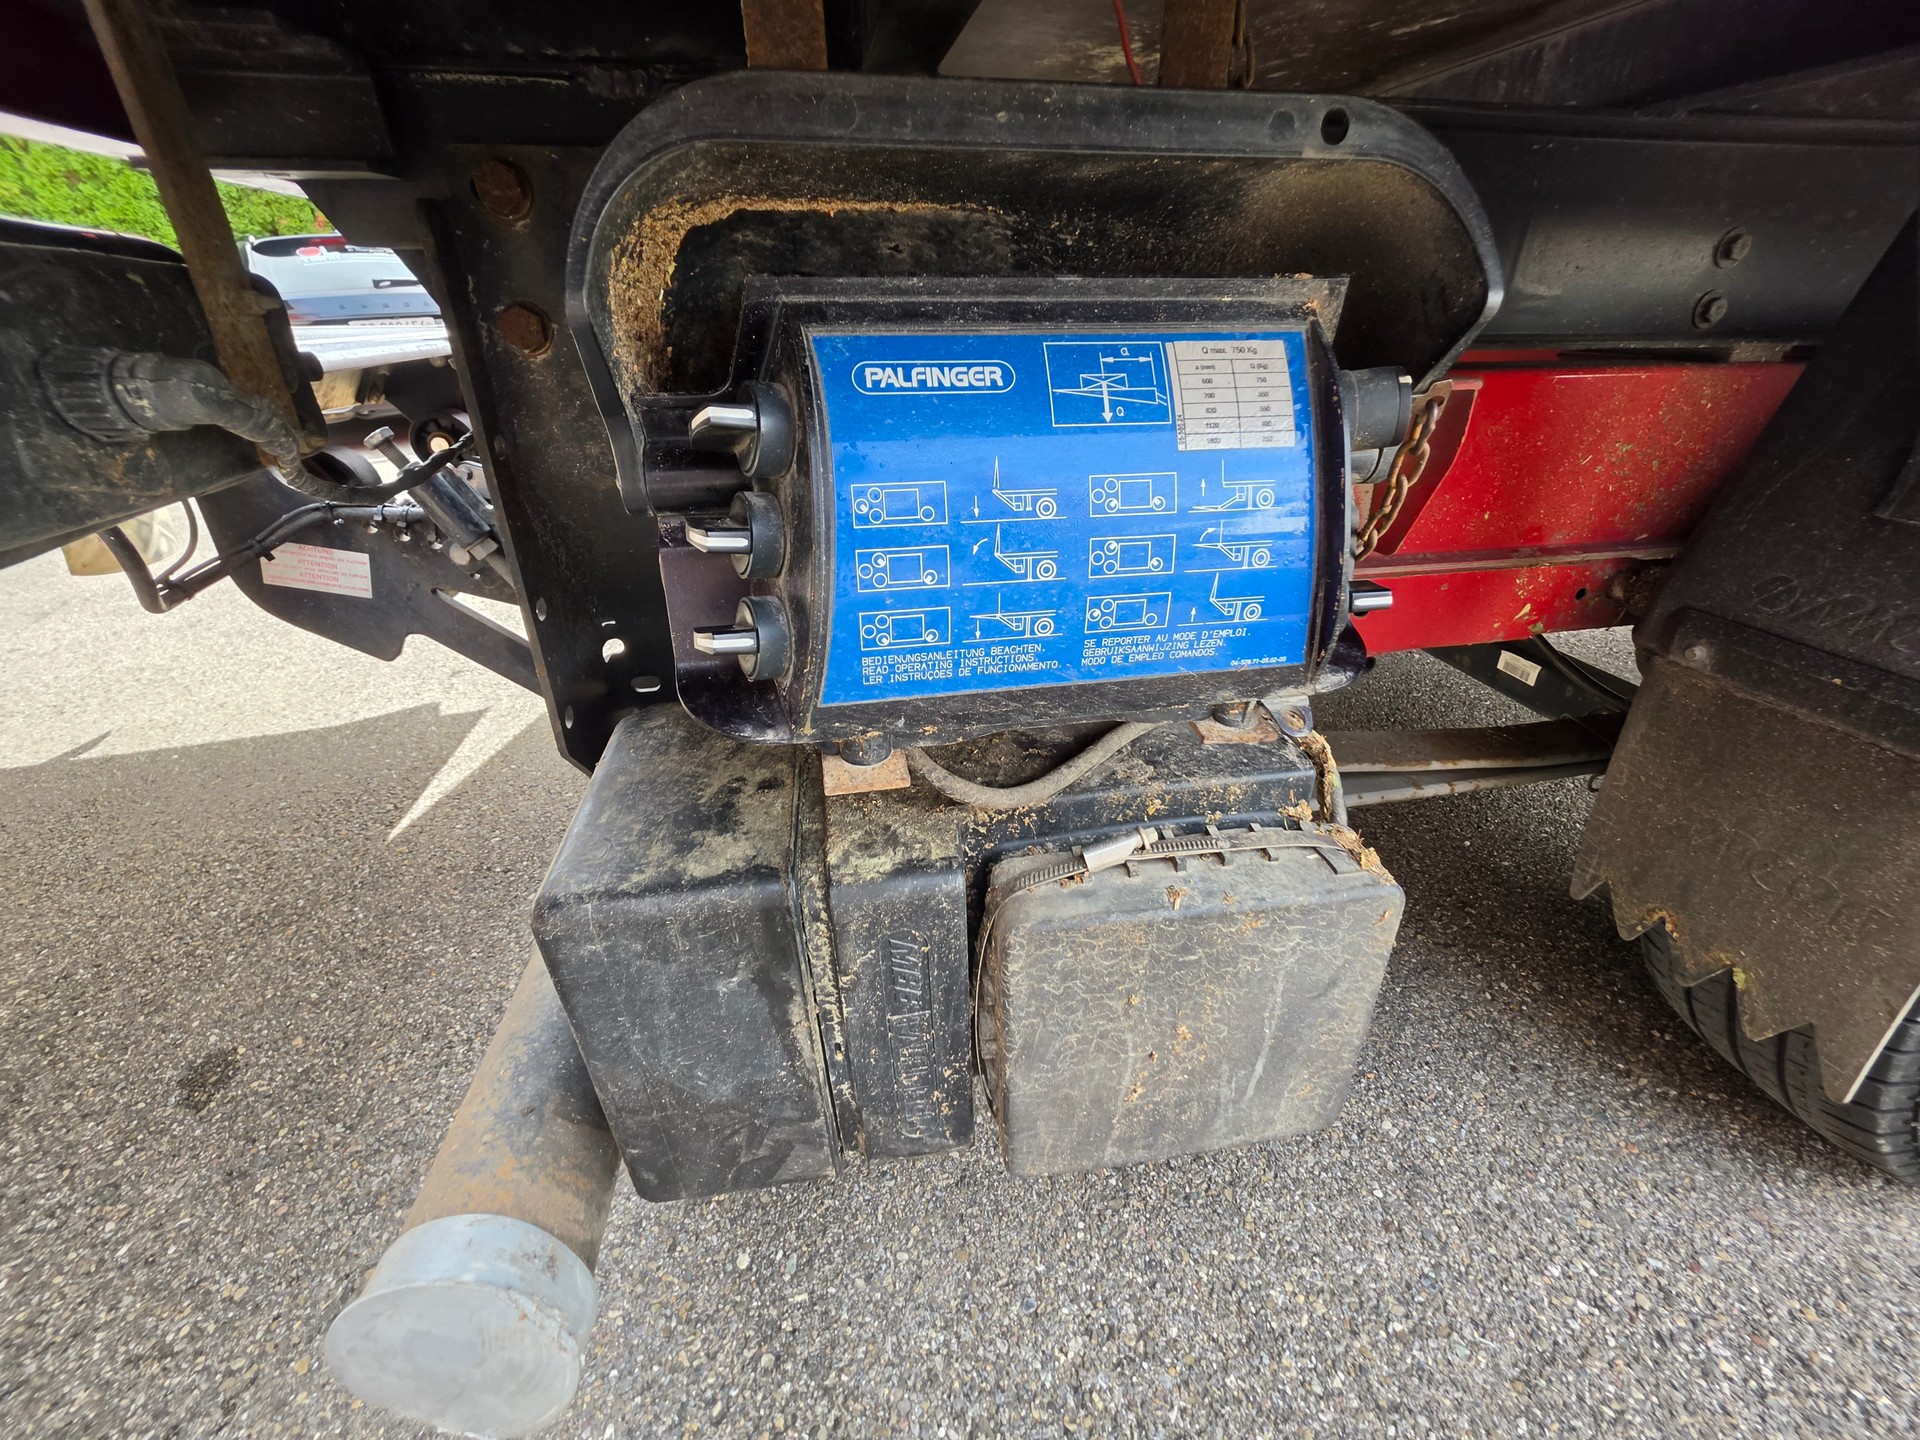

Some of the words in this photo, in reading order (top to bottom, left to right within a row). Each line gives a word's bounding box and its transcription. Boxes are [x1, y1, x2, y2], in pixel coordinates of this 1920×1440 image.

[1201, 346, 1209, 355] Q
[1231, 346, 1245, 354] 750
[1247, 346, 1258, 355] Kg
[864, 366, 1004, 388] PALFINGER
[1116, 406, 1125, 417] Q
[298, 559, 338, 570] ATTENTION
[300, 572, 339, 583] ATTENTION
[1084, 638, 1097, 648] SE
[1102, 635, 1151, 647] REPORTER
[1155, 633, 1169, 642] AU
[1173, 631, 1197, 641] MODE
[1201, 628, 1251, 640] D'EMPLOI.
[862, 648, 985, 666] BEDIENUNGSANLEITUNG
[991, 643, 1046, 656] BEACHTEN.
[1081, 656, 1106, 666] MODO
[1111, 655, 1124, 664] DE
[1129, 651, 1164, 662] EMPLEO
[1169, 647, 1218, 660] COMANDOS.
[1083, 641, 1189, 657] GEBRUIKSAANWIJZING
[1194, 639, 1226, 649] LEZEN.
[862, 666, 889, 676] READ
[895, 660, 953, 673] OPERATING
[960, 653, 1038, 667] INSTRUCTIONS.
[863, 675, 882, 685] LER
[958, 667, 972, 677] DE
